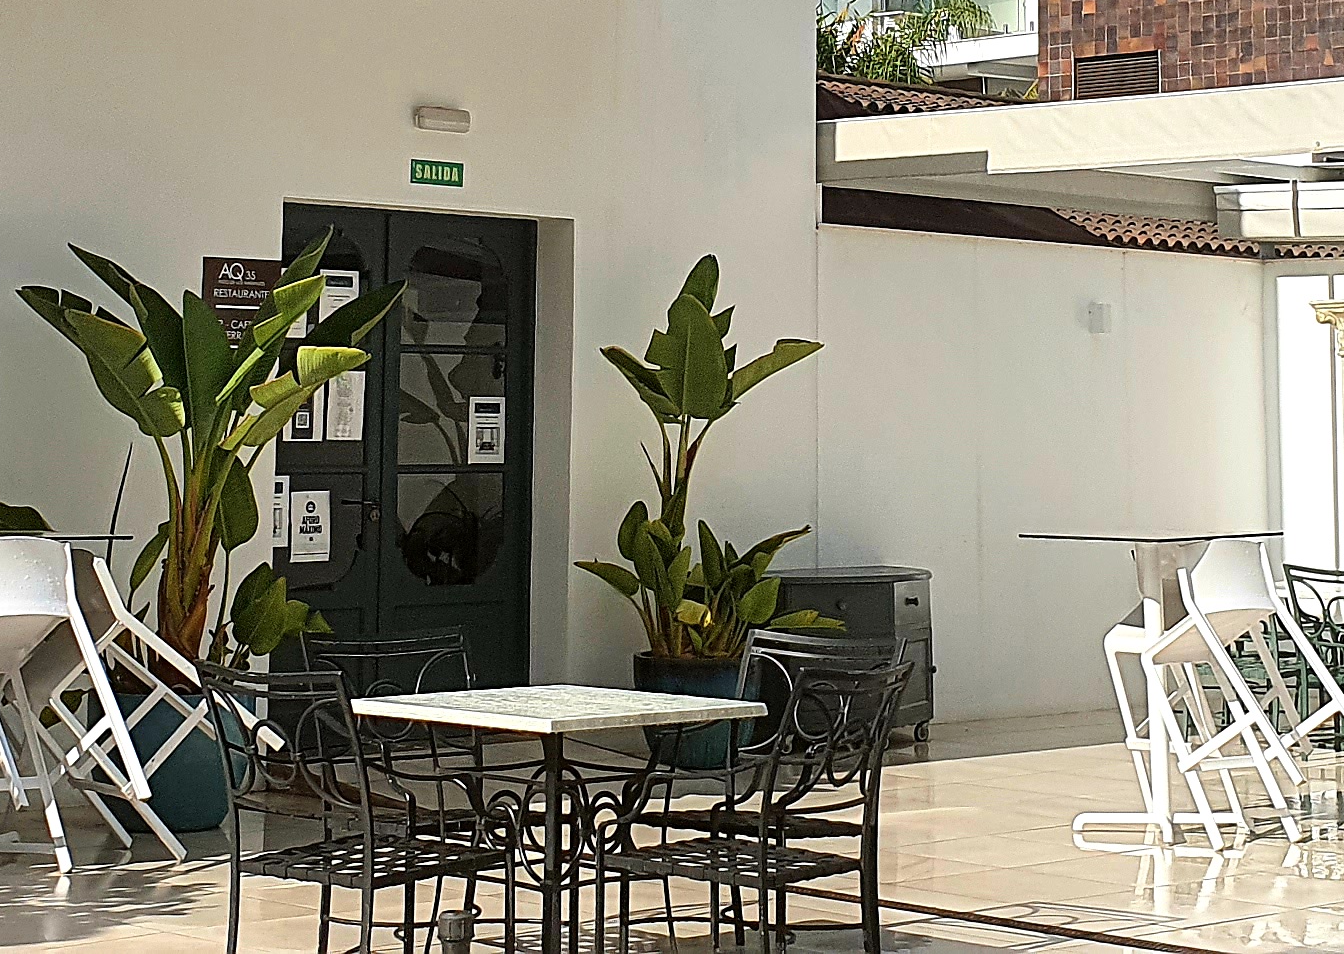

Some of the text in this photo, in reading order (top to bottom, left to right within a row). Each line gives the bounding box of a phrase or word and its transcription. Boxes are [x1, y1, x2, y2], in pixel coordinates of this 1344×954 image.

[415, 163, 459, 182] SALIDA
[218, 263, 256, 281] AQ 35
